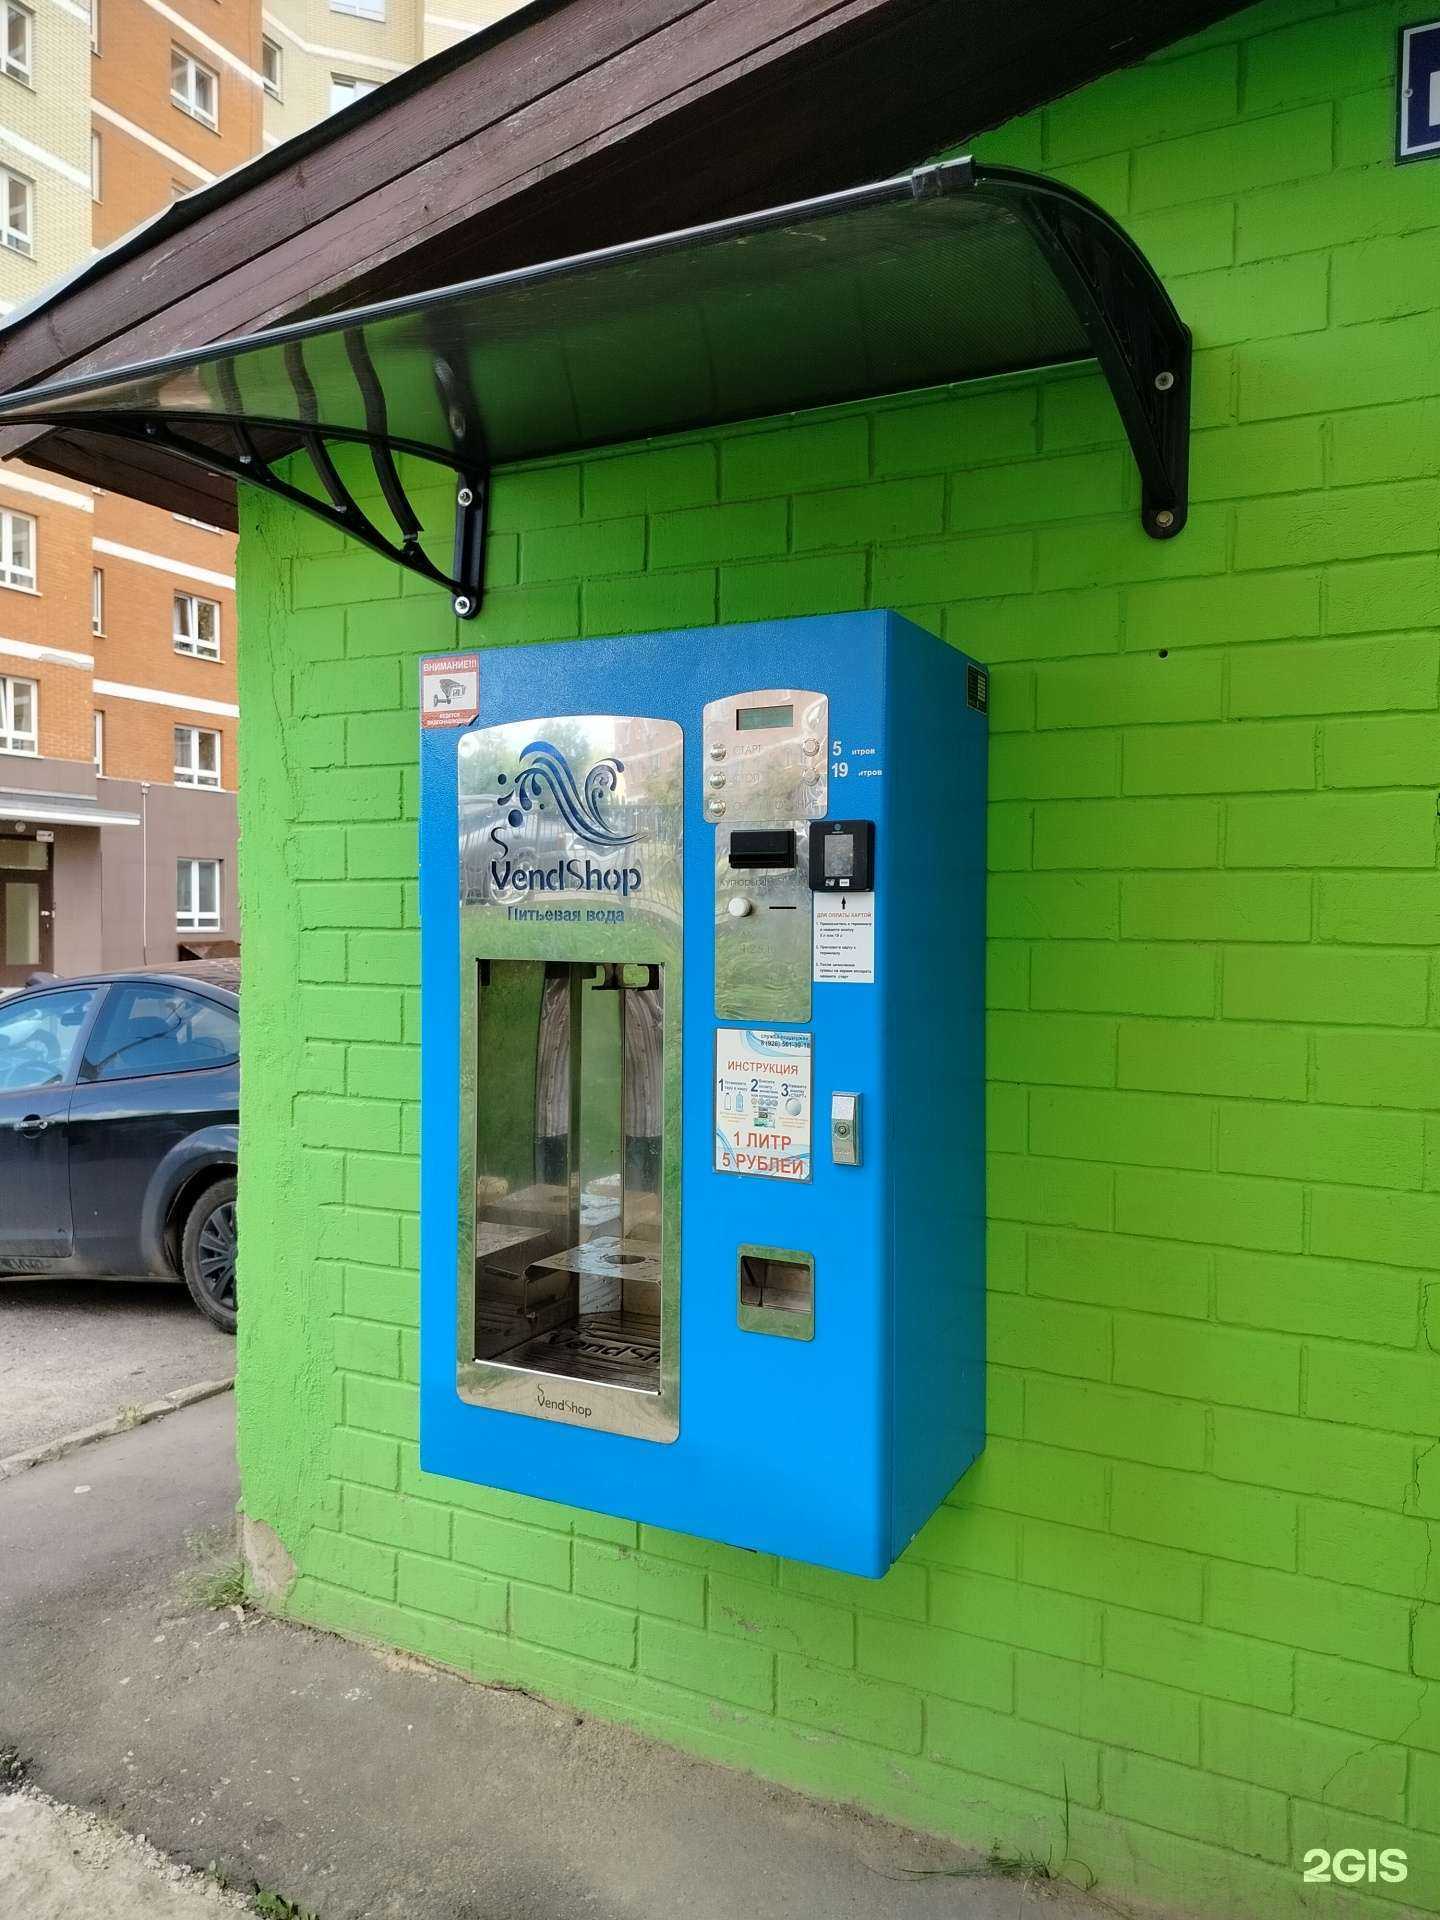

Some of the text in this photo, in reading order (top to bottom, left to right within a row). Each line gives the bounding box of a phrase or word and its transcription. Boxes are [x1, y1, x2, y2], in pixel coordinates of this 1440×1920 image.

[831, 740, 842, 756] 5
[831, 762, 849, 778] 19
[491, 859, 642, 897] VendShop
[507, 906, 625, 925] Питьевая вода
[727, 1060, 799, 1076] ИНСТРУКЦИЯ
[718, 1078, 724, 1092] 1
[750, 1078, 759, 1093] 2
[780, 1083, 789, 1097] 3
[733, 1131, 792, 1151] 1 ЛИТР
[722, 1152, 731, 1167] 5
[537, 1395, 593, 1419] VendShop
